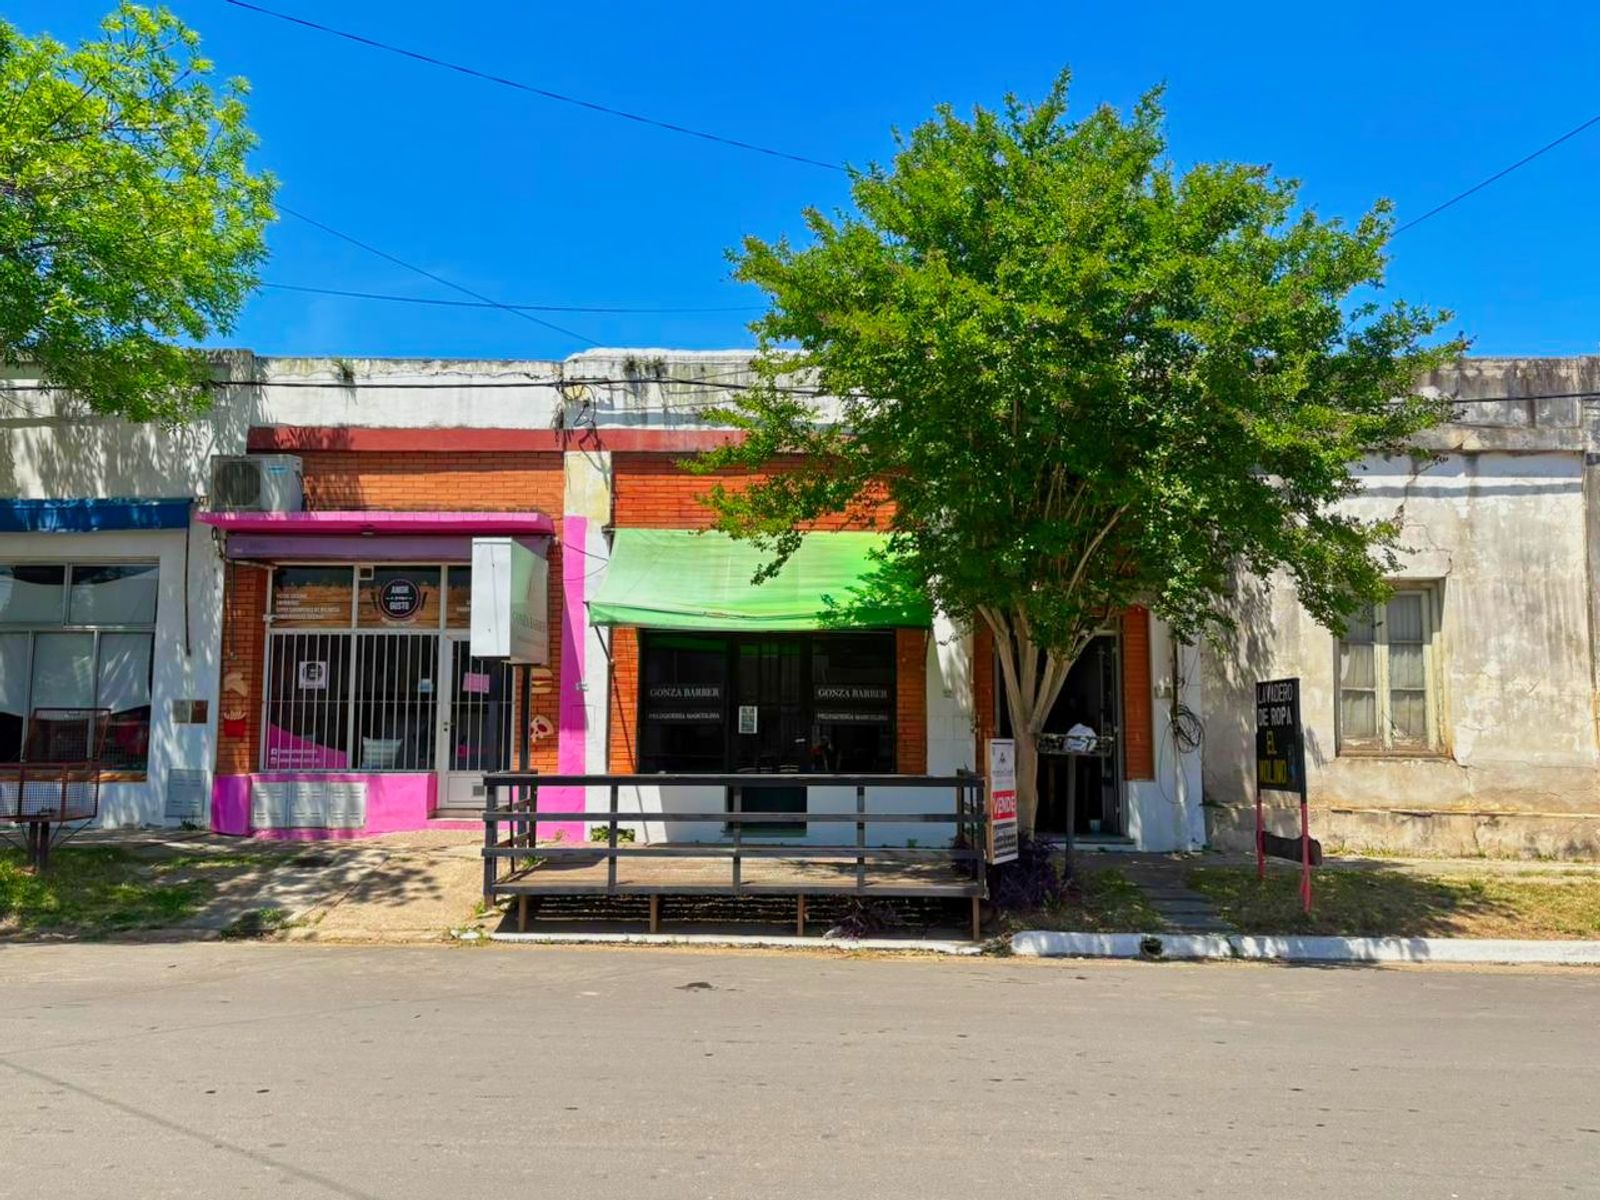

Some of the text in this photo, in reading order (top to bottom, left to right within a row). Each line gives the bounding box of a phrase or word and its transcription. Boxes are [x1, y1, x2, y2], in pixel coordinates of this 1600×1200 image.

[649, 688, 719, 698] GONZA BARBER
[818, 689, 887, 698] GONZA BARBER
[1257, 683, 1293, 704] LAVADERO
[1258, 706, 1293, 726] DE ROPA
